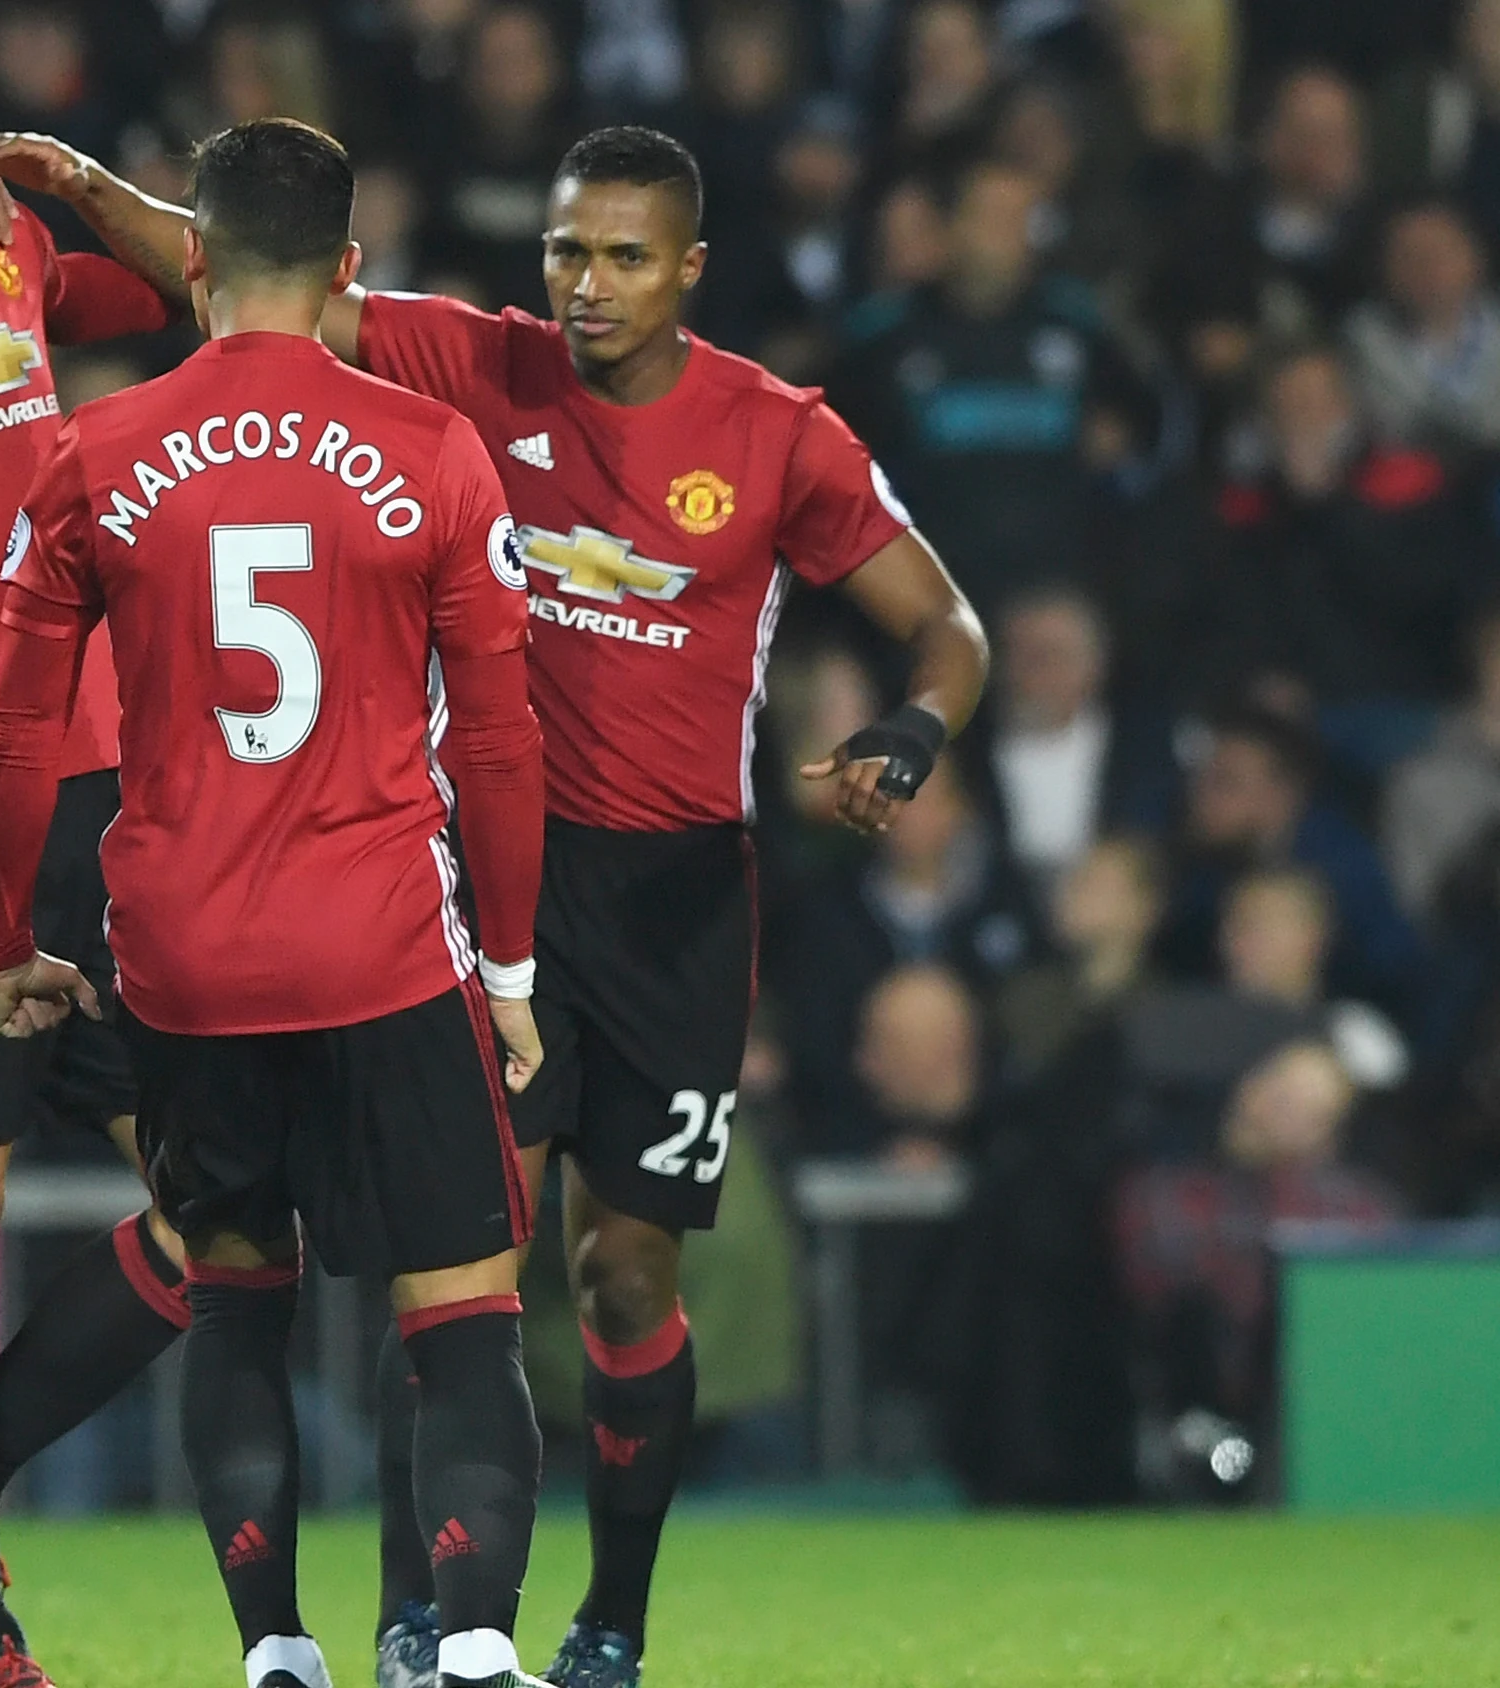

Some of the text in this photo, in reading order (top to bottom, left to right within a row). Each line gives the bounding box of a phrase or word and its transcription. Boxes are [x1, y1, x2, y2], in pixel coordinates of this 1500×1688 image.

[99, 411, 423, 547] MARCOS ROJO
[209, 523, 322, 763] 5
[526, 594, 691, 649] HEVROLET
[638, 1089, 737, 1184] 25
